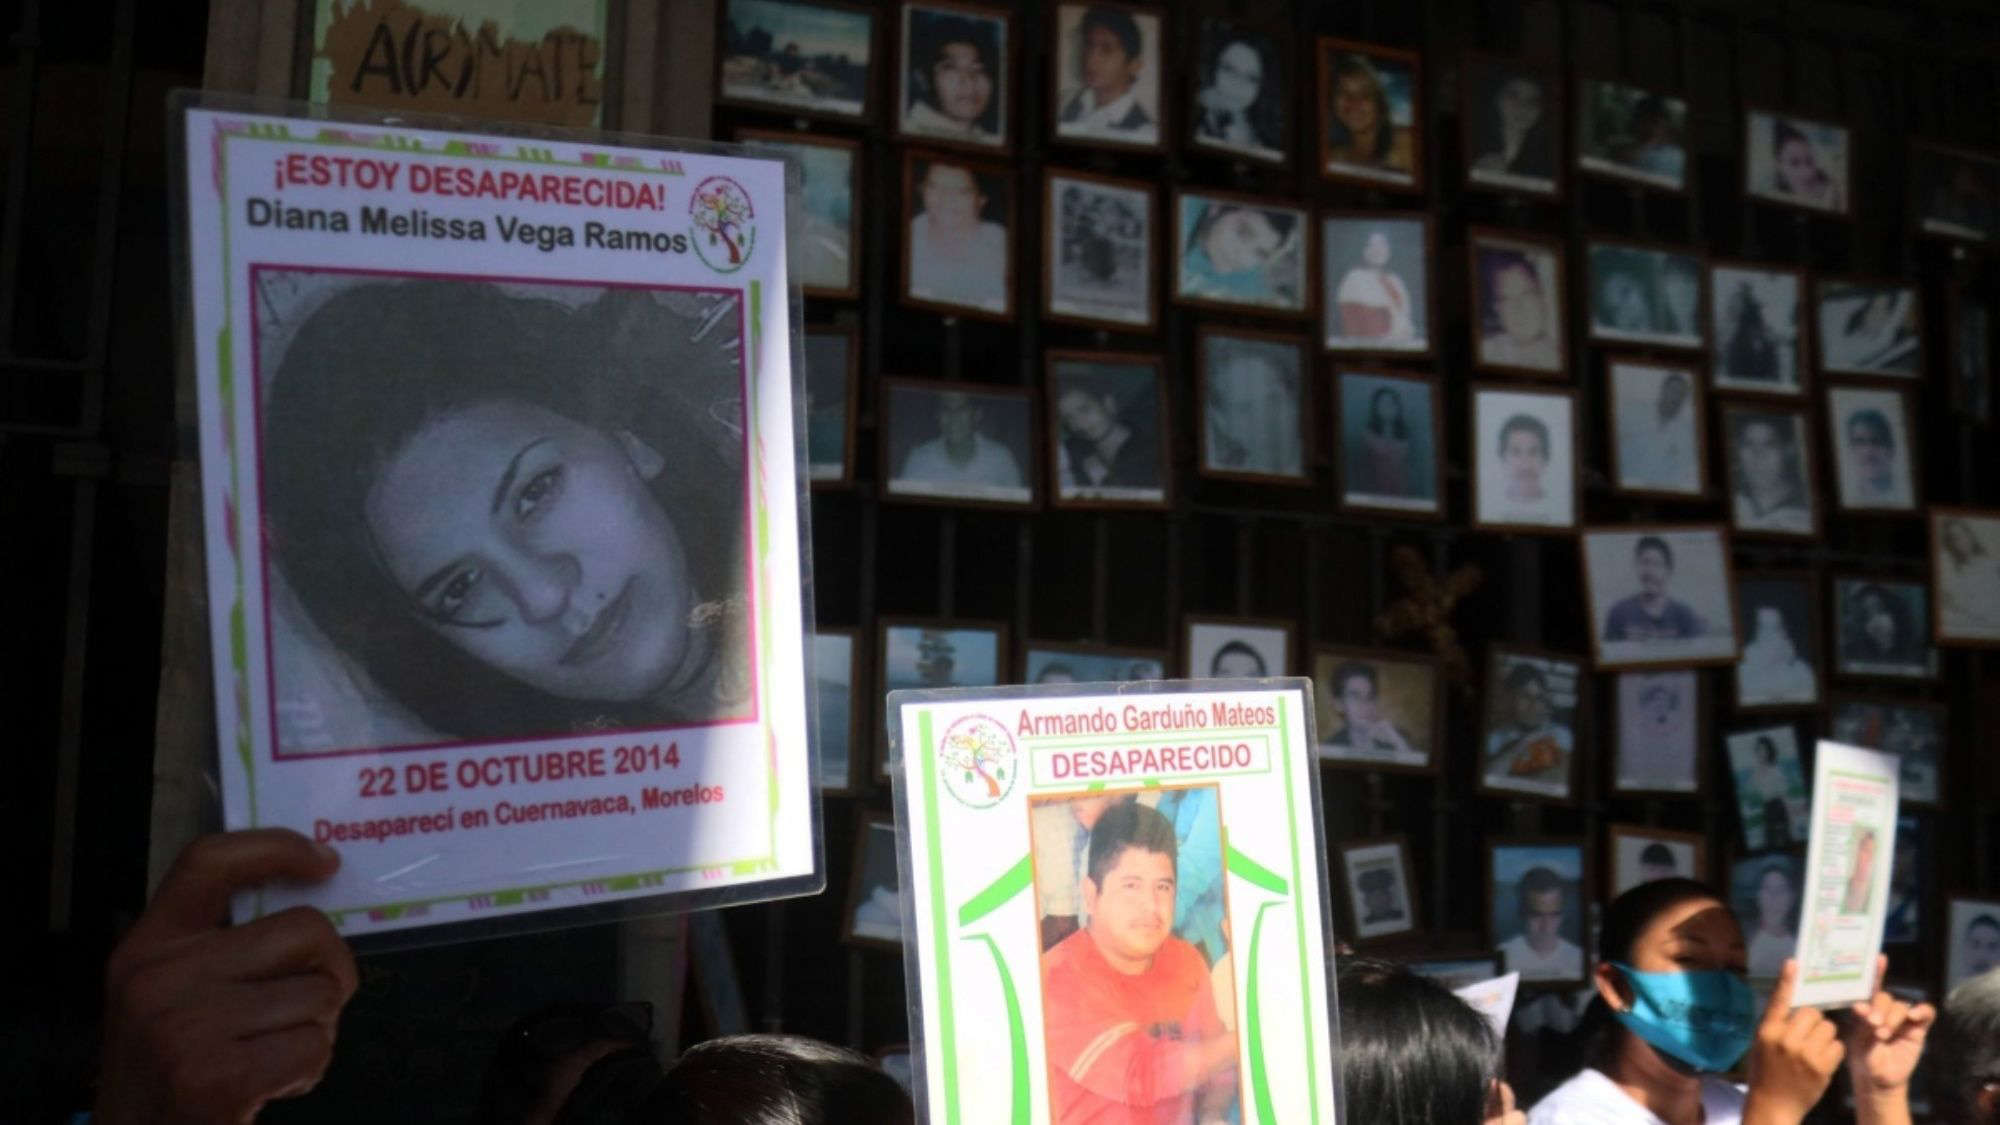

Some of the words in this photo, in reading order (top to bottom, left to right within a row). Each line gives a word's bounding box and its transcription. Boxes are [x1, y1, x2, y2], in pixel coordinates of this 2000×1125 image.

[275, 153, 400, 191] ¡ESTOY
[409, 163, 665, 212] DESAPARECIDA!
[246, 197, 349, 233] Diana
[360, 206, 487, 241] Melissa
[495, 215, 575, 253] Vega
[584, 221, 688, 254] Ramos
[1017, 706, 1118, 737] Armando
[1122, 703, 1208, 732] Garduño
[1211, 701, 1276, 727] Mateos
[358, 767, 397, 798] 22
[404, 761, 450, 794] DE
[455, 747, 606, 789] OCTUBRE
[613, 741, 681, 775] 2014
[1051, 743, 1252, 780] DESAPARECIDO
[313, 806, 456, 844] Desaparecí
[459, 808, 490, 829] en
[494, 793, 636, 826] Cuernavaca,
[641, 783, 725, 810] Morelos
